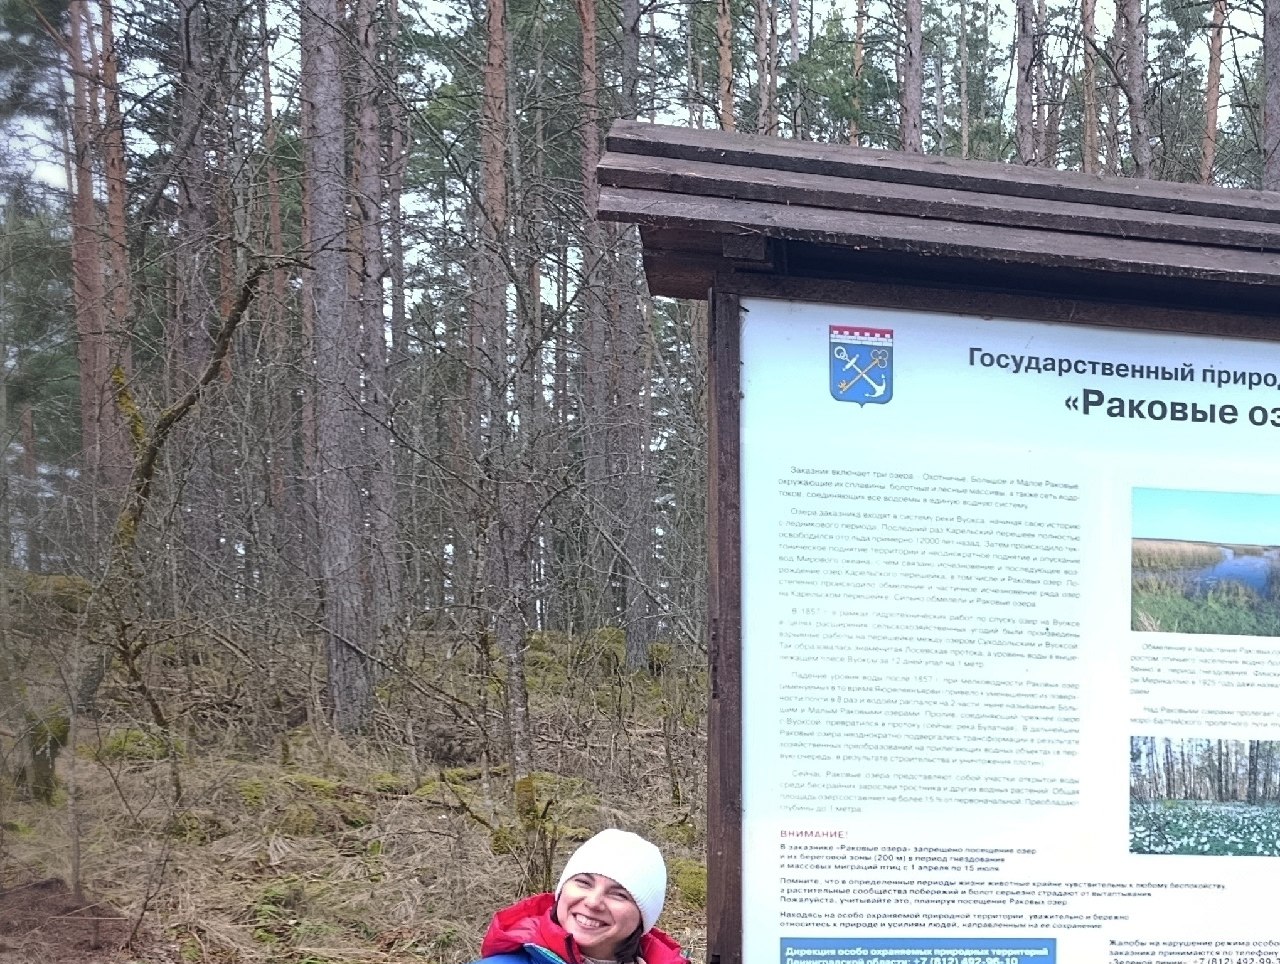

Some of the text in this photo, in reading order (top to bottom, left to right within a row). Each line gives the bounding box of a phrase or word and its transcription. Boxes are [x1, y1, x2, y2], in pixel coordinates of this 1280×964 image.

[968, 347, 1195, 383] Государственный
[1065, 388, 1239, 425] «Раковые
[785, 946, 1048, 958] Дирекция особо охраняемых природных территорий
[912, 956, 927, 964] +7
[1192, 957, 1205, 964] +7
